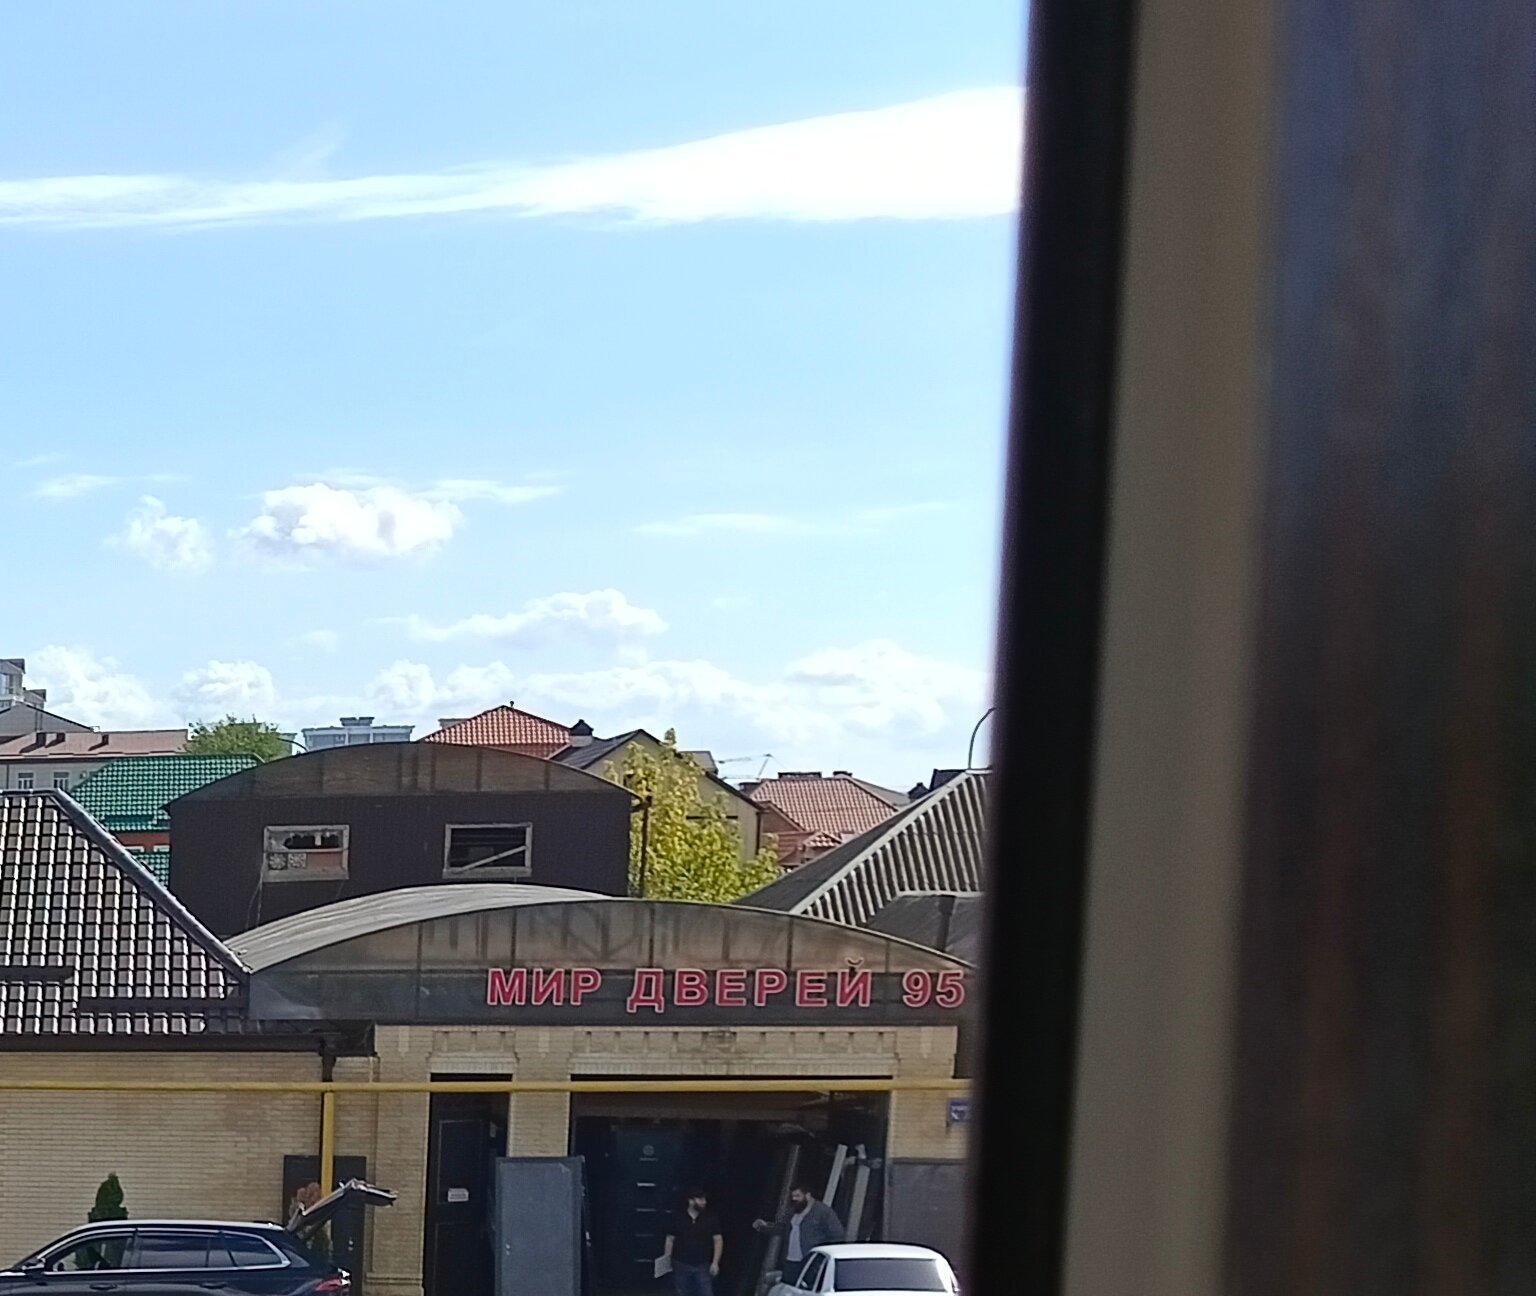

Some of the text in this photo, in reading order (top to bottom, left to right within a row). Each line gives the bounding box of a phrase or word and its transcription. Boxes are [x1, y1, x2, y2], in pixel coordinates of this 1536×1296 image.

[487, 957, 965, 1014] МИР ДВЕРЕЙ 95
